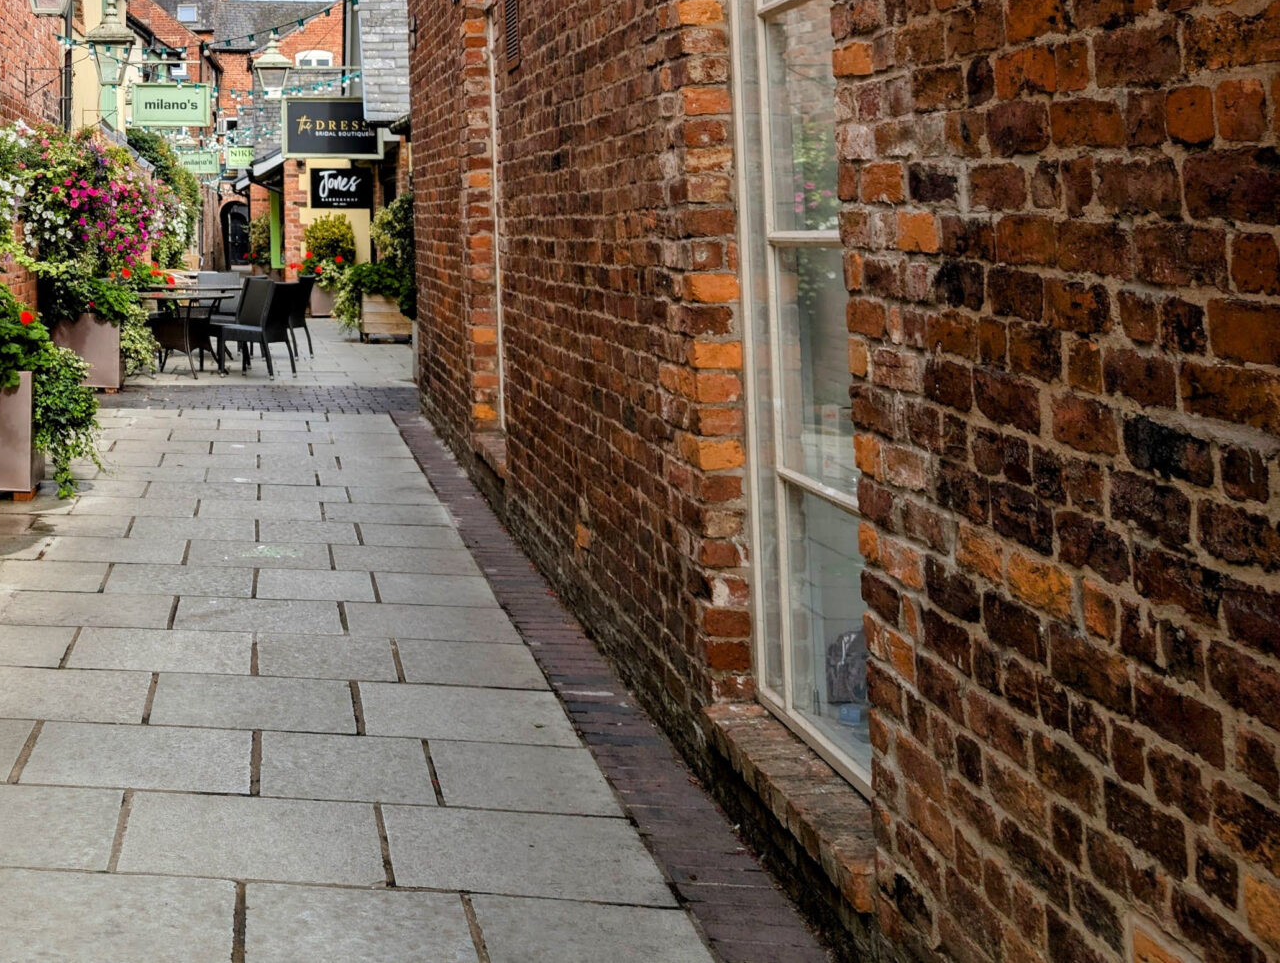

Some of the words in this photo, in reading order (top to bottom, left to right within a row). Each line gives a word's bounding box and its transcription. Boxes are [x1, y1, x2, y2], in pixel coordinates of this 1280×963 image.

[144, 98, 198, 110] milano's
[296, 114, 313, 136] the
[338, 130, 369, 138] BOUTIQUE
[319, 170, 362, 198] Jones
